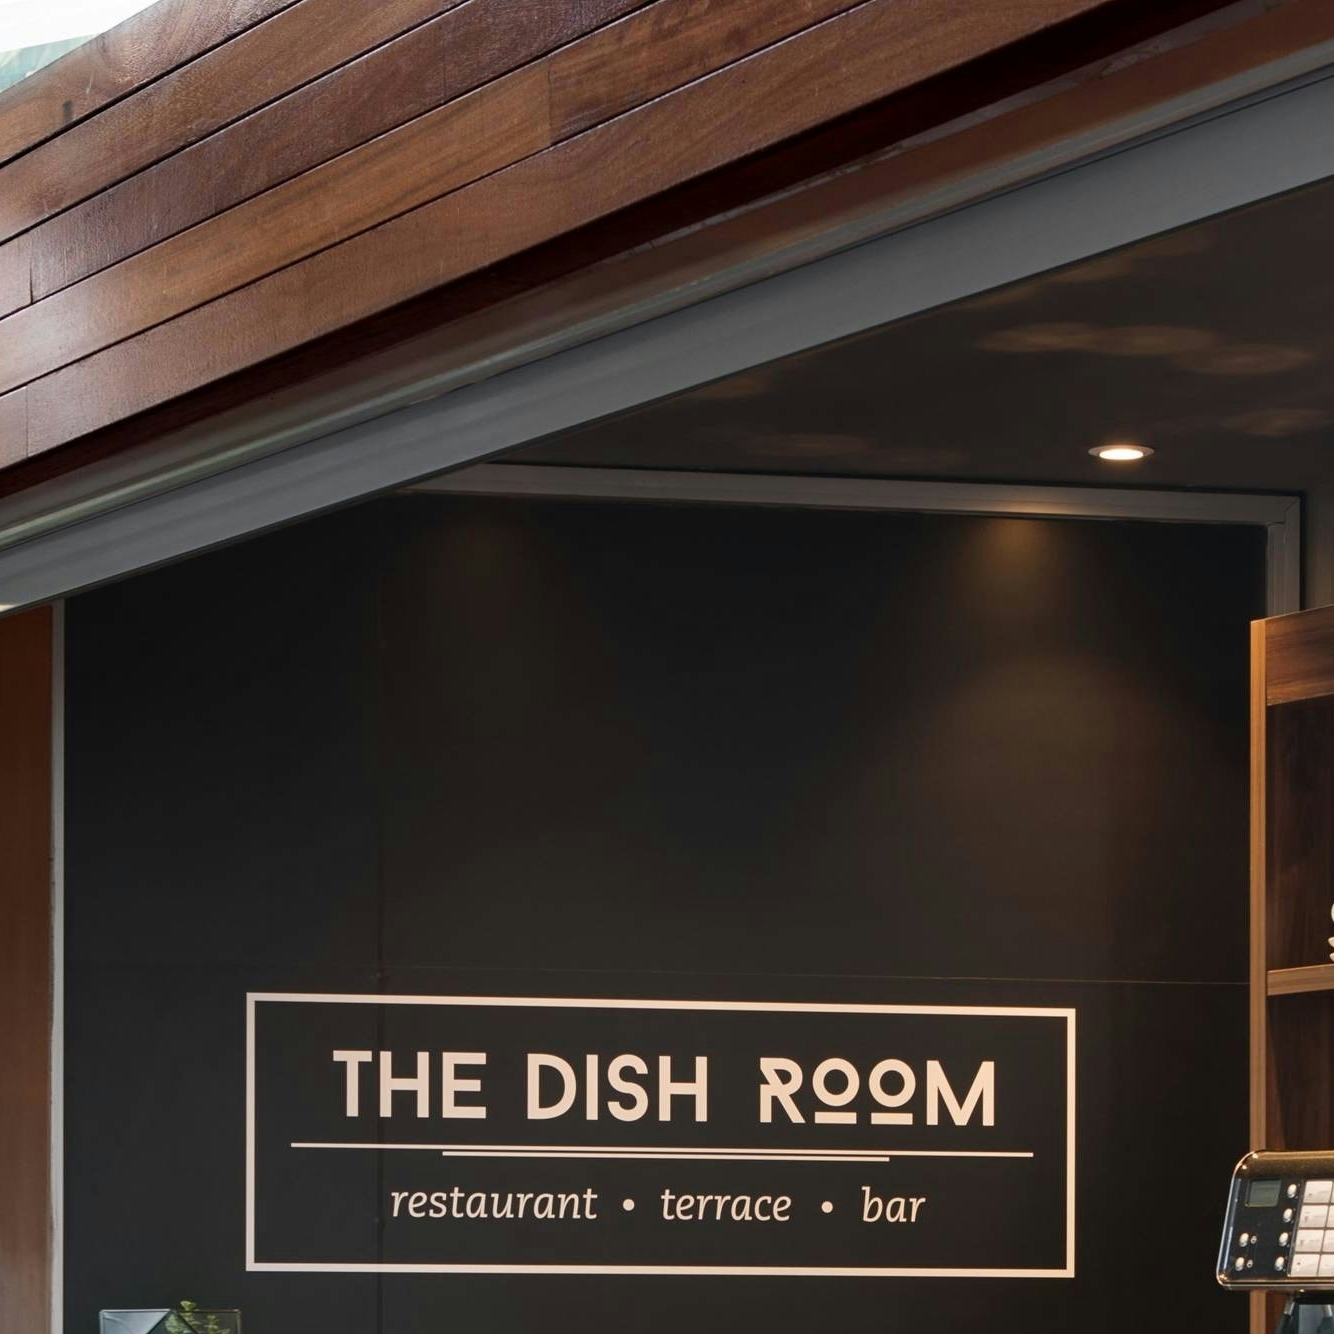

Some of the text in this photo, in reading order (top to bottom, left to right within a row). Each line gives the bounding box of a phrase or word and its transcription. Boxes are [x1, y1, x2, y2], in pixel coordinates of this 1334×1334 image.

[332, 1049, 995, 1127] THE DISH ROOM
[390, 1185, 927, 1223] restaurant terrace bar
